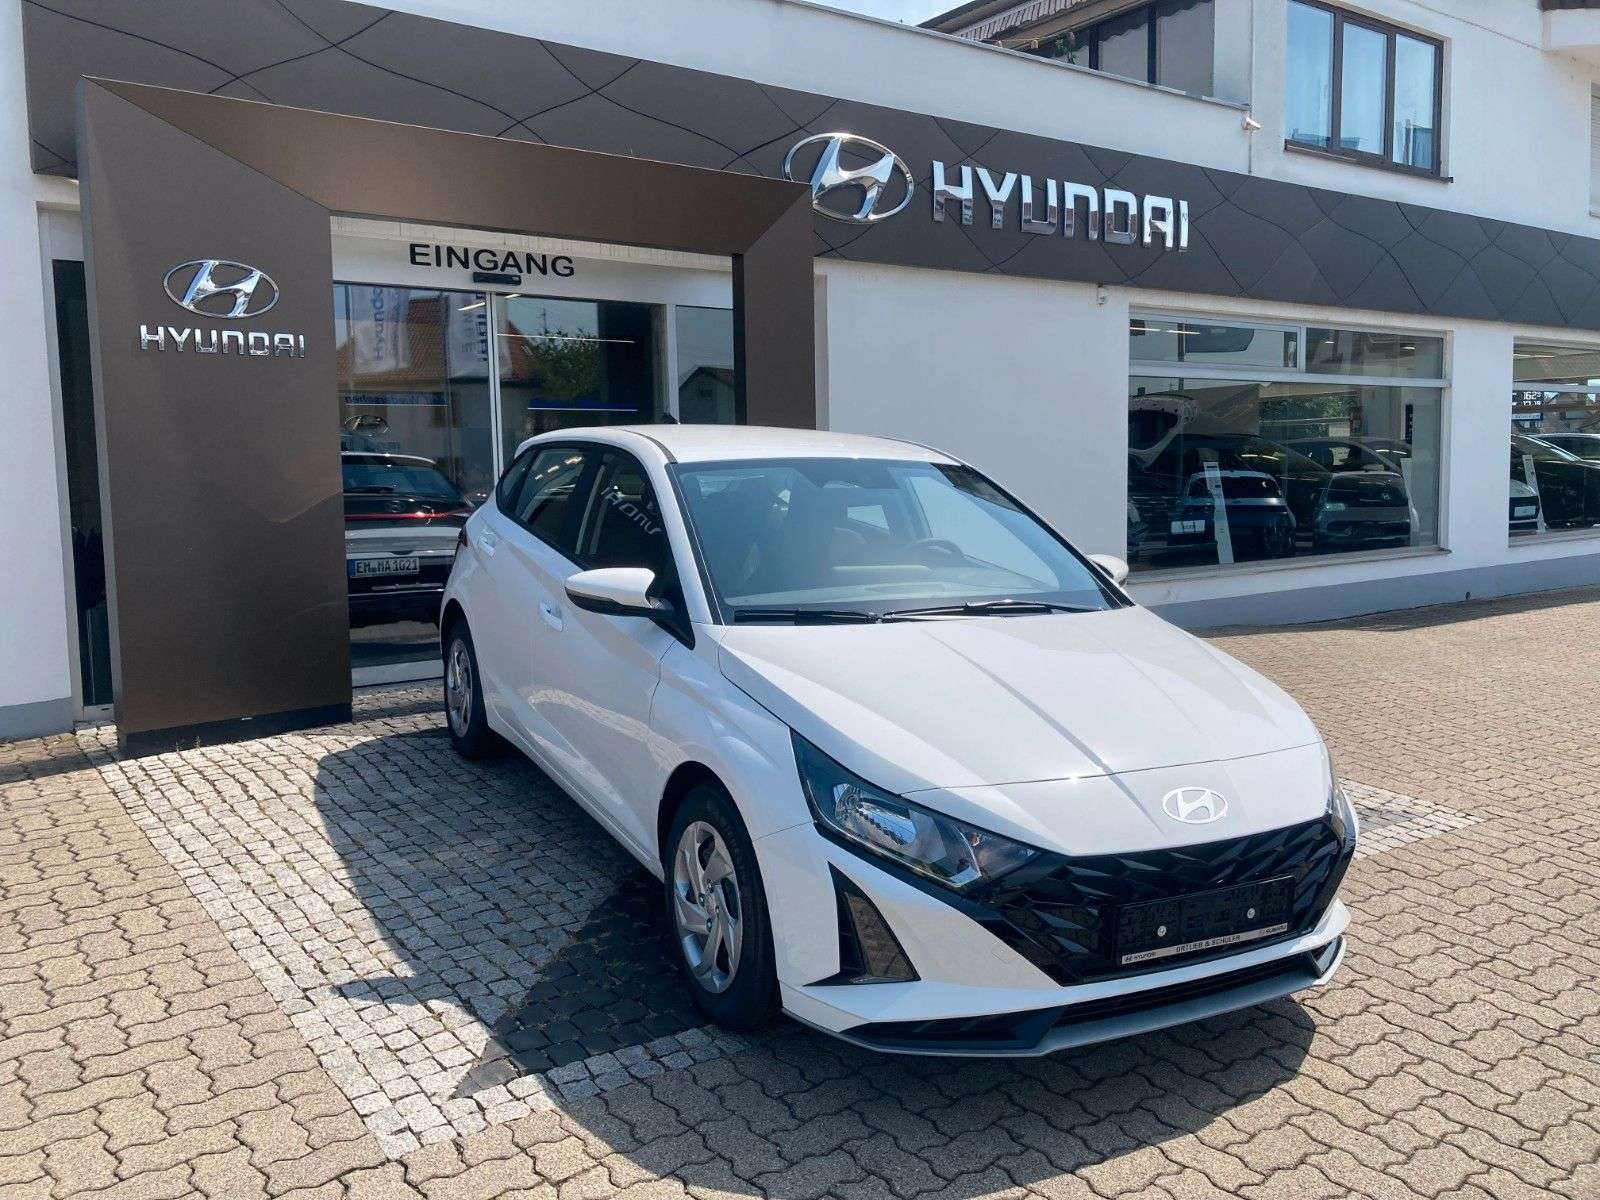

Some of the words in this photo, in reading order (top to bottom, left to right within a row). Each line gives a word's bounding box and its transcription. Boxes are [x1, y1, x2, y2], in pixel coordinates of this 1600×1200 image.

[932, 160, 1189, 252] HYUNDAI
[409, 243, 575, 278] EINGANG
[140, 324, 305, 358] HYUNDAI
